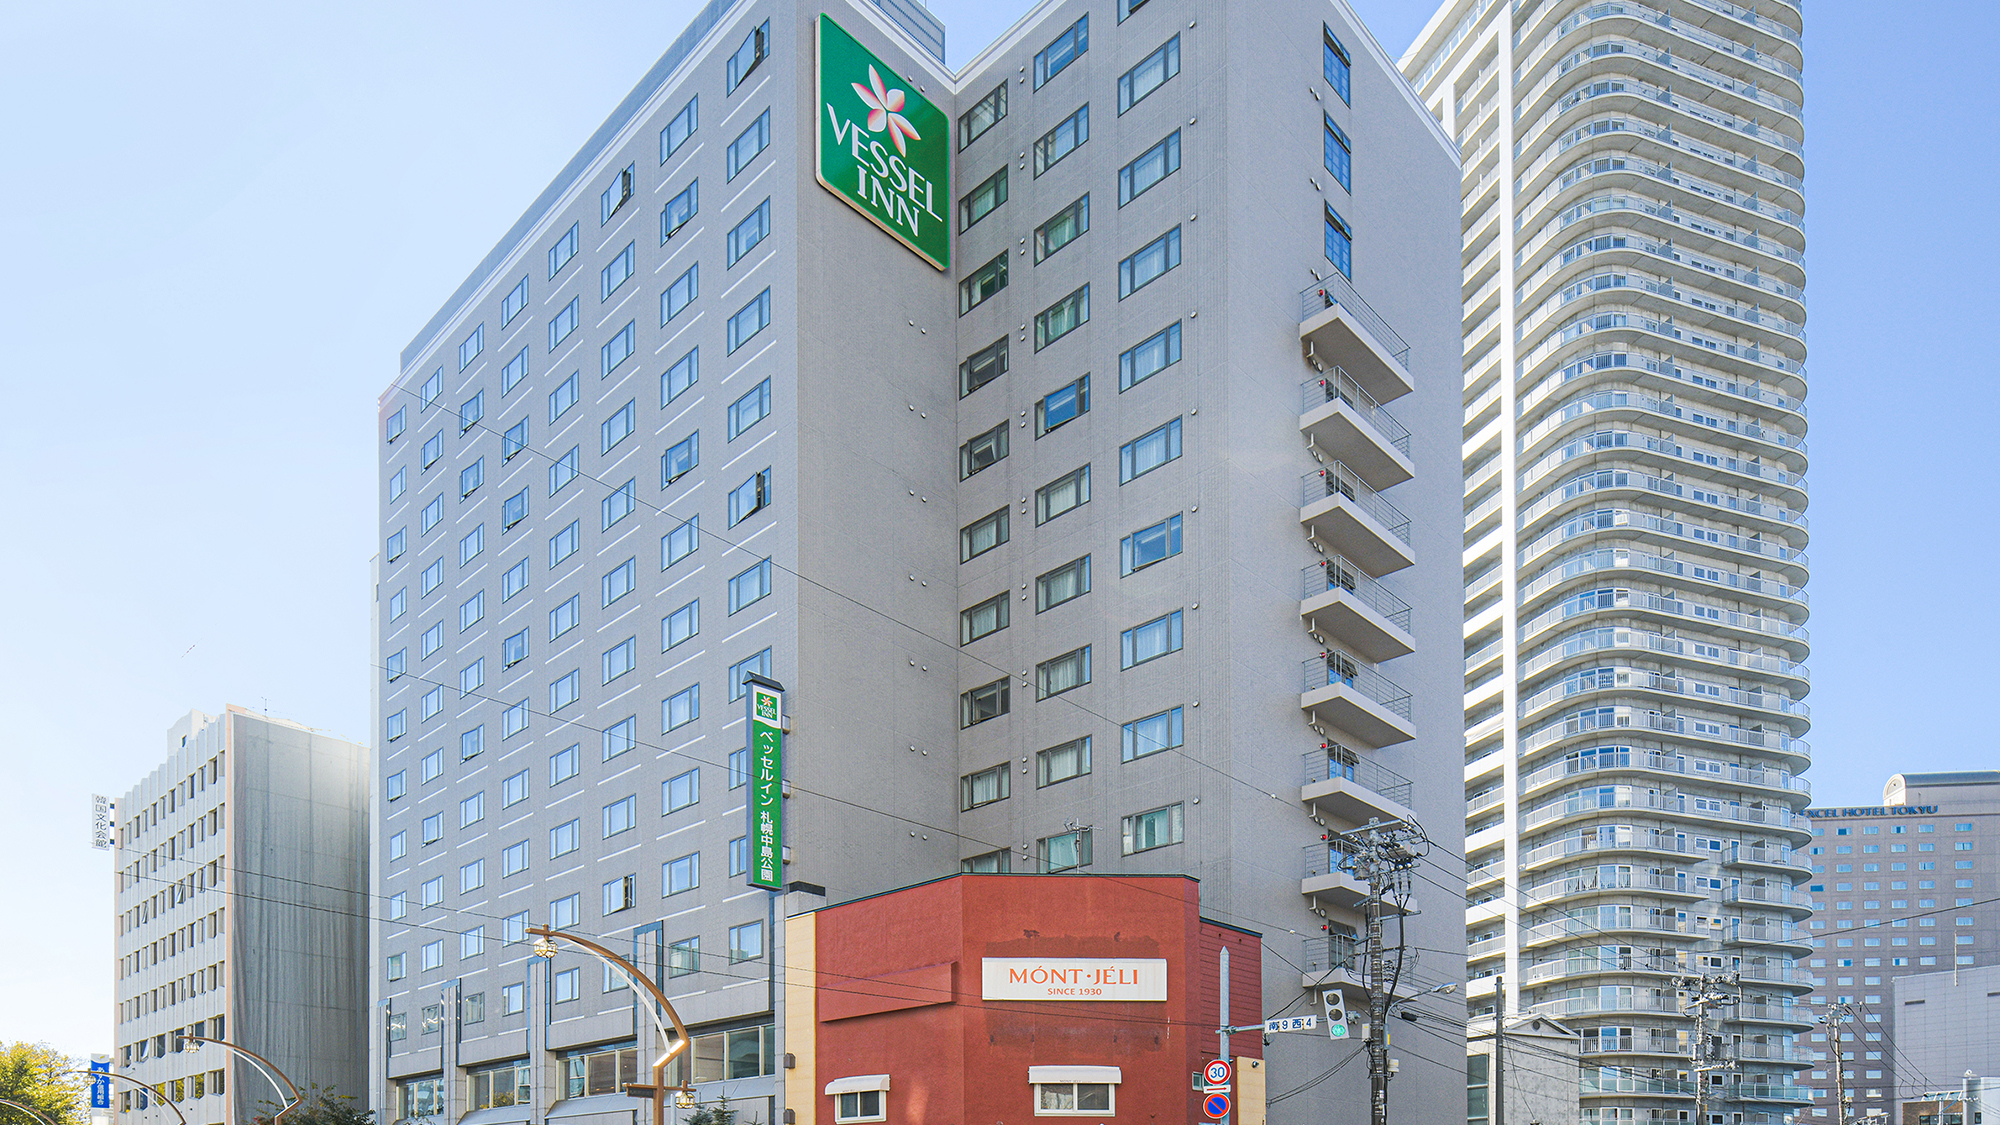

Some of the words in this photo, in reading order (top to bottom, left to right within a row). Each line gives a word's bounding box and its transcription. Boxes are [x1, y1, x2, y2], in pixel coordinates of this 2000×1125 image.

[826, 102, 943, 223] VESSEL
[856, 164, 920, 237] INN
[757, 703, 777, 715] VESSEL
[761, 710, 774, 719] INN
[760, 731, 774, 806] ベッセルイン
[95, 795, 107, 848] 韓国文化会館
[1842, 807, 1888, 817] HOTEL
[1892, 805, 1939, 815] TOKYU
[760, 810, 774, 882] 札幌中島公園
[1047, 988, 1076, 996] SINCE
[1079, 988, 1102, 996] 1930
[1210, 1067, 1225, 1079] 30
